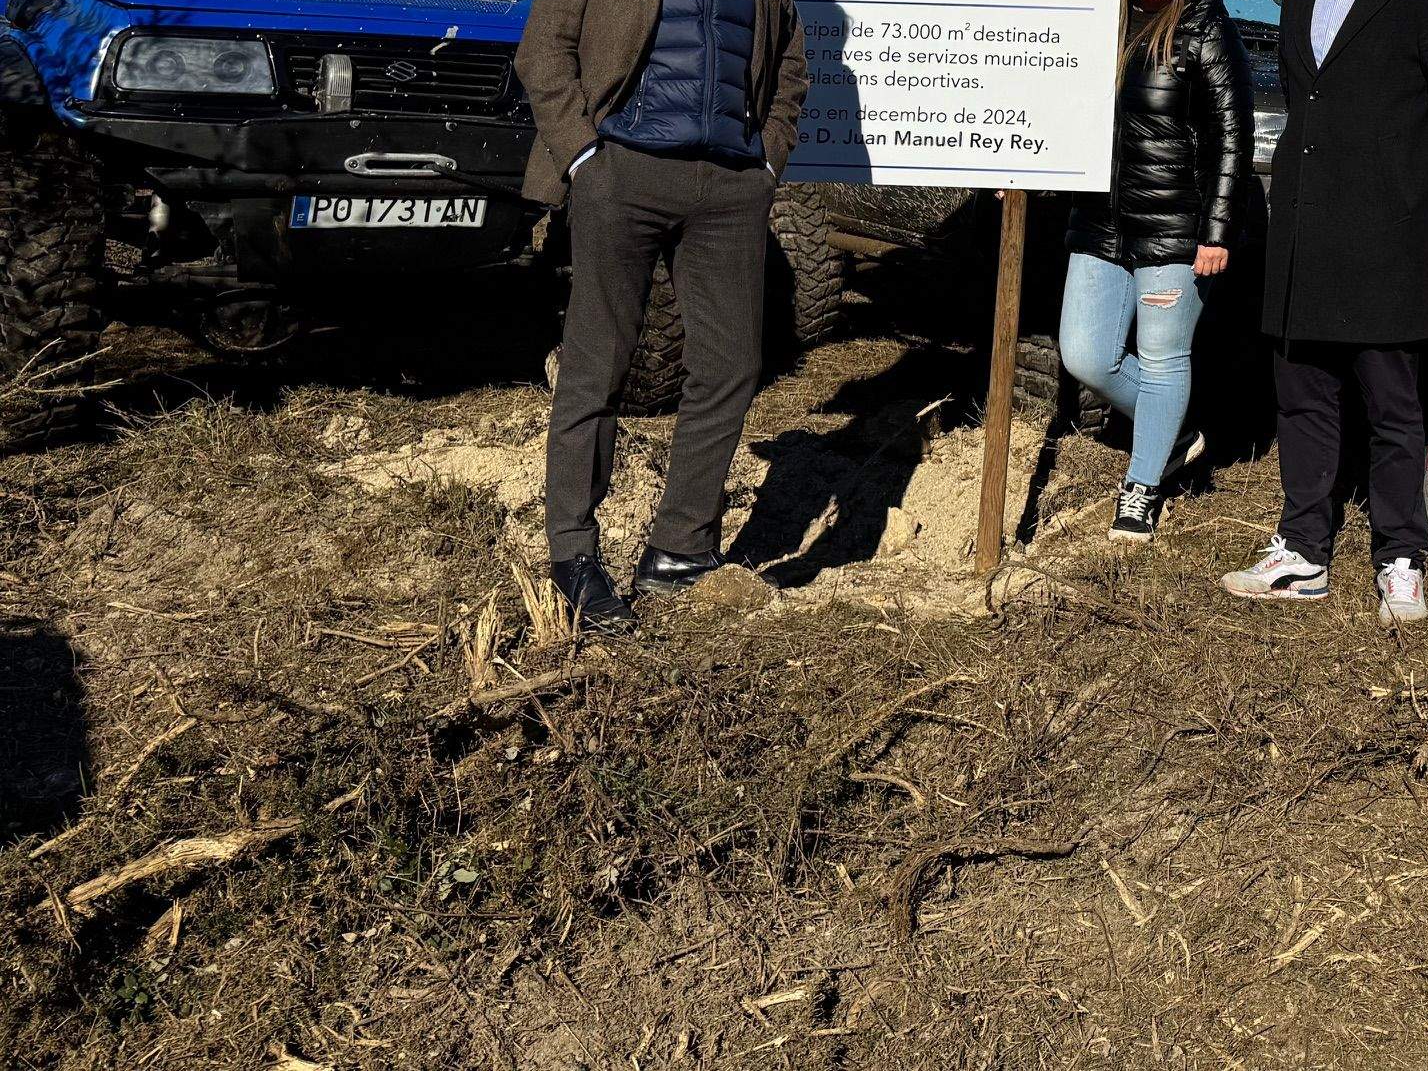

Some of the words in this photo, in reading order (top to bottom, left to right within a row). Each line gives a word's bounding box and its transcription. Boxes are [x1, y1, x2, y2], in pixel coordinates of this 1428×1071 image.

[803, 20, 846, 40] cipal
[851, 21, 874, 38] de
[881, 22, 942, 40] 73.000
[973, 24, 1060, 44] destinada
[822, 49, 873, 62] naves
[879, 46, 902, 63] de
[907, 48, 978, 65] servizos
[984, 51, 1079, 72] municipais
[808, 68, 878, 87] alacións
[884, 70, 984, 91] deportivas.
[827, 108, 848, 120] en
[855, 105, 947, 123] decembro
[954, 107, 976, 124] de
[983, 108, 1031, 128] 2024,
[816, 127, 836, 144] D.
[842, 128, 887, 146] Juan
[894, 130, 963, 148] Manuel
[970, 132, 1004, 153] Rey
[1010, 133, 1049, 155] Rey.
